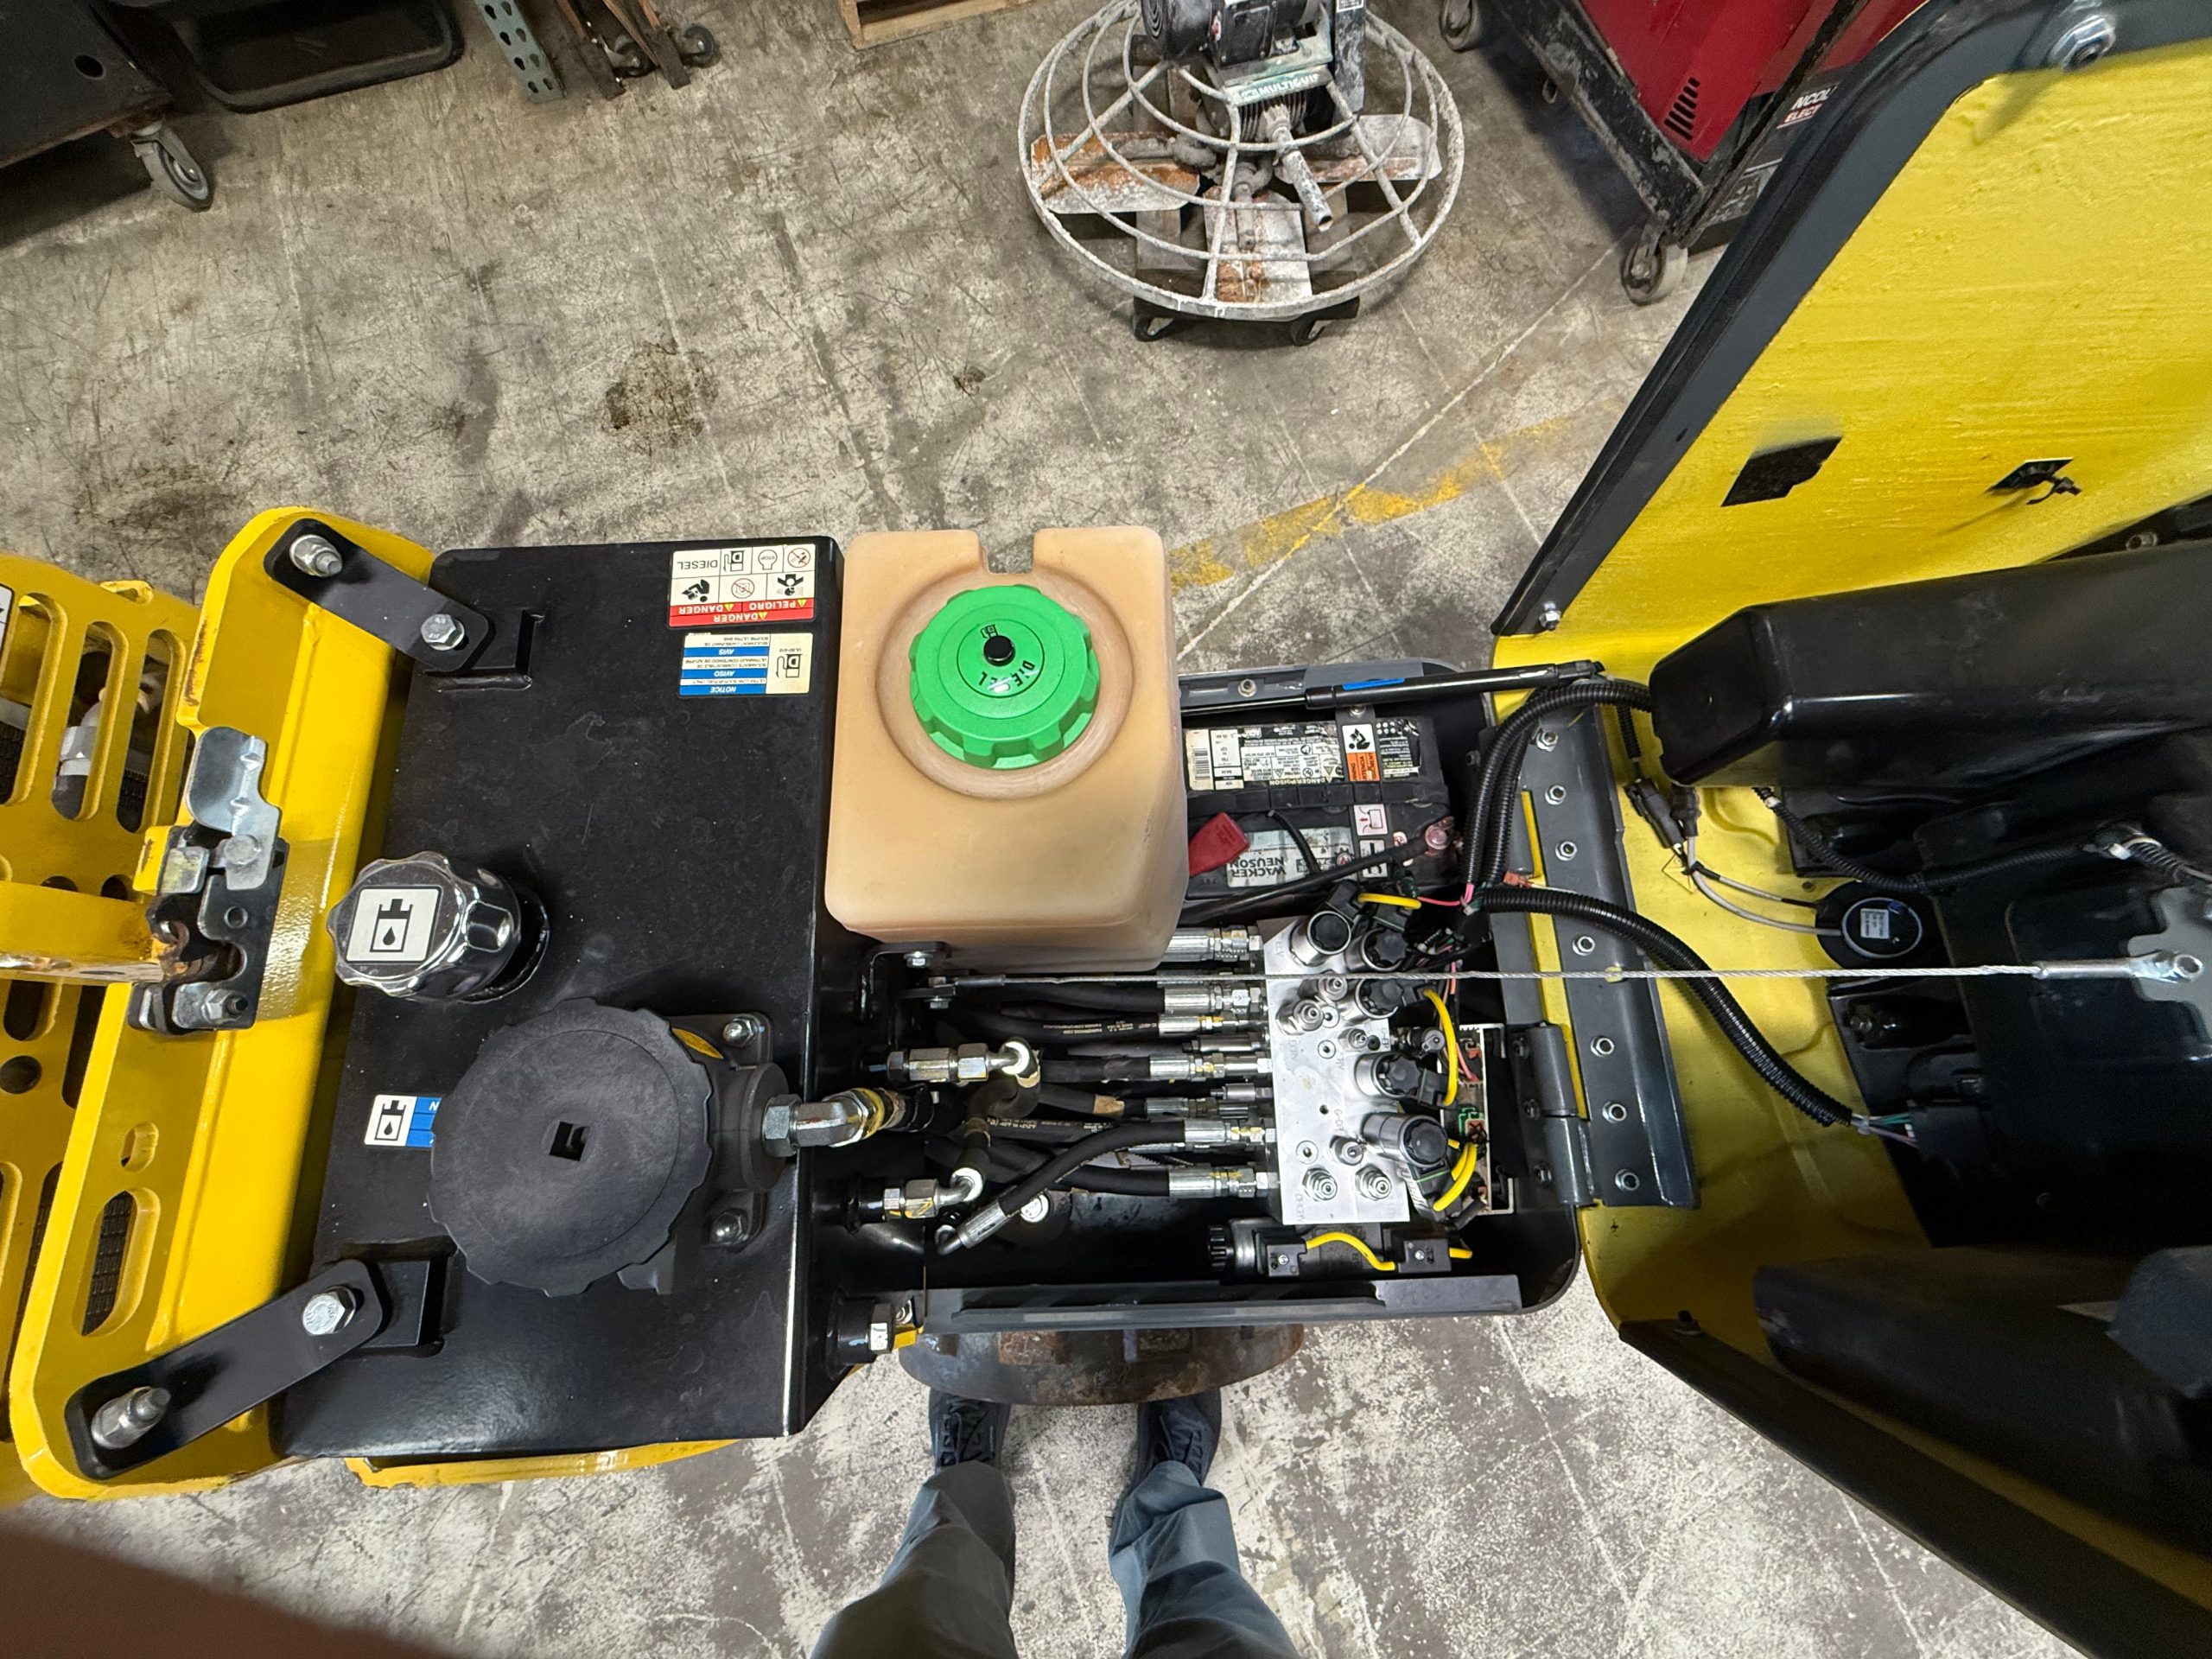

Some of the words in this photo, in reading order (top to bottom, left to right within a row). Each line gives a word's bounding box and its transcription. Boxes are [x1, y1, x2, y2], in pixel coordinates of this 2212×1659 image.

[677, 559, 718, 569] DIESEL
[679, 604, 723, 613] DANGER
[749, 601, 796, 610] PELIGRO
[714, 613, 758, 622] DANGER
[979, 660, 1036, 690] DIEEL
[1230, 857, 1285, 868] NEUSON
[1230, 867, 1286, 877] WACKER
